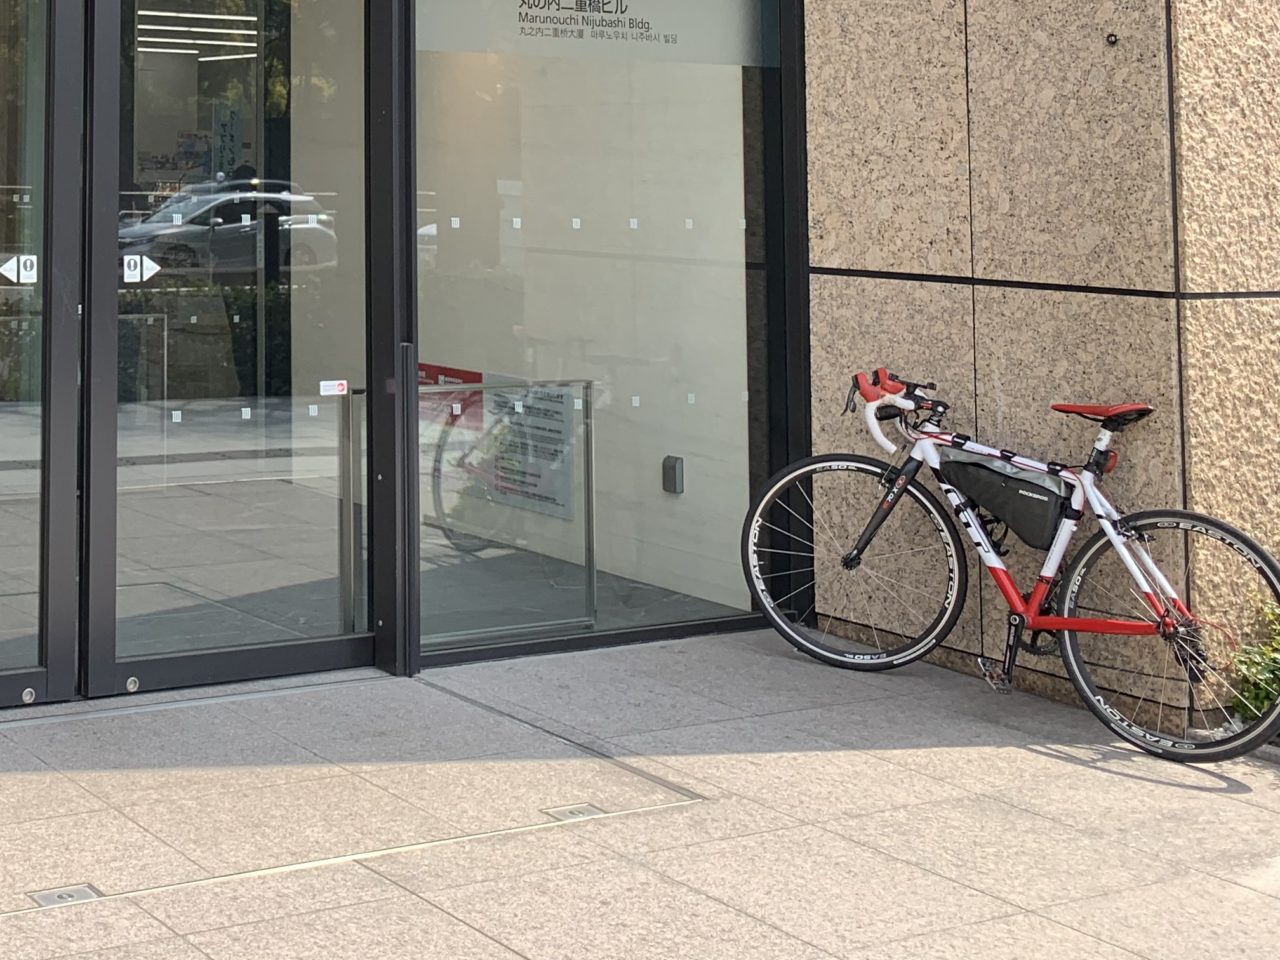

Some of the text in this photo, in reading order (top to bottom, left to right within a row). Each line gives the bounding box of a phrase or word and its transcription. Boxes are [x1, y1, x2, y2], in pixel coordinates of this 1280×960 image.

[518, 12, 653, 32] Marunouchi Nijubashi Bldg.
[751, 517, 766, 591] EASTON
[940, 530, 956, 608] EASTON
[1178, 521, 1261, 569] EASTON
[1094, 695, 1174, 748] EASTON
